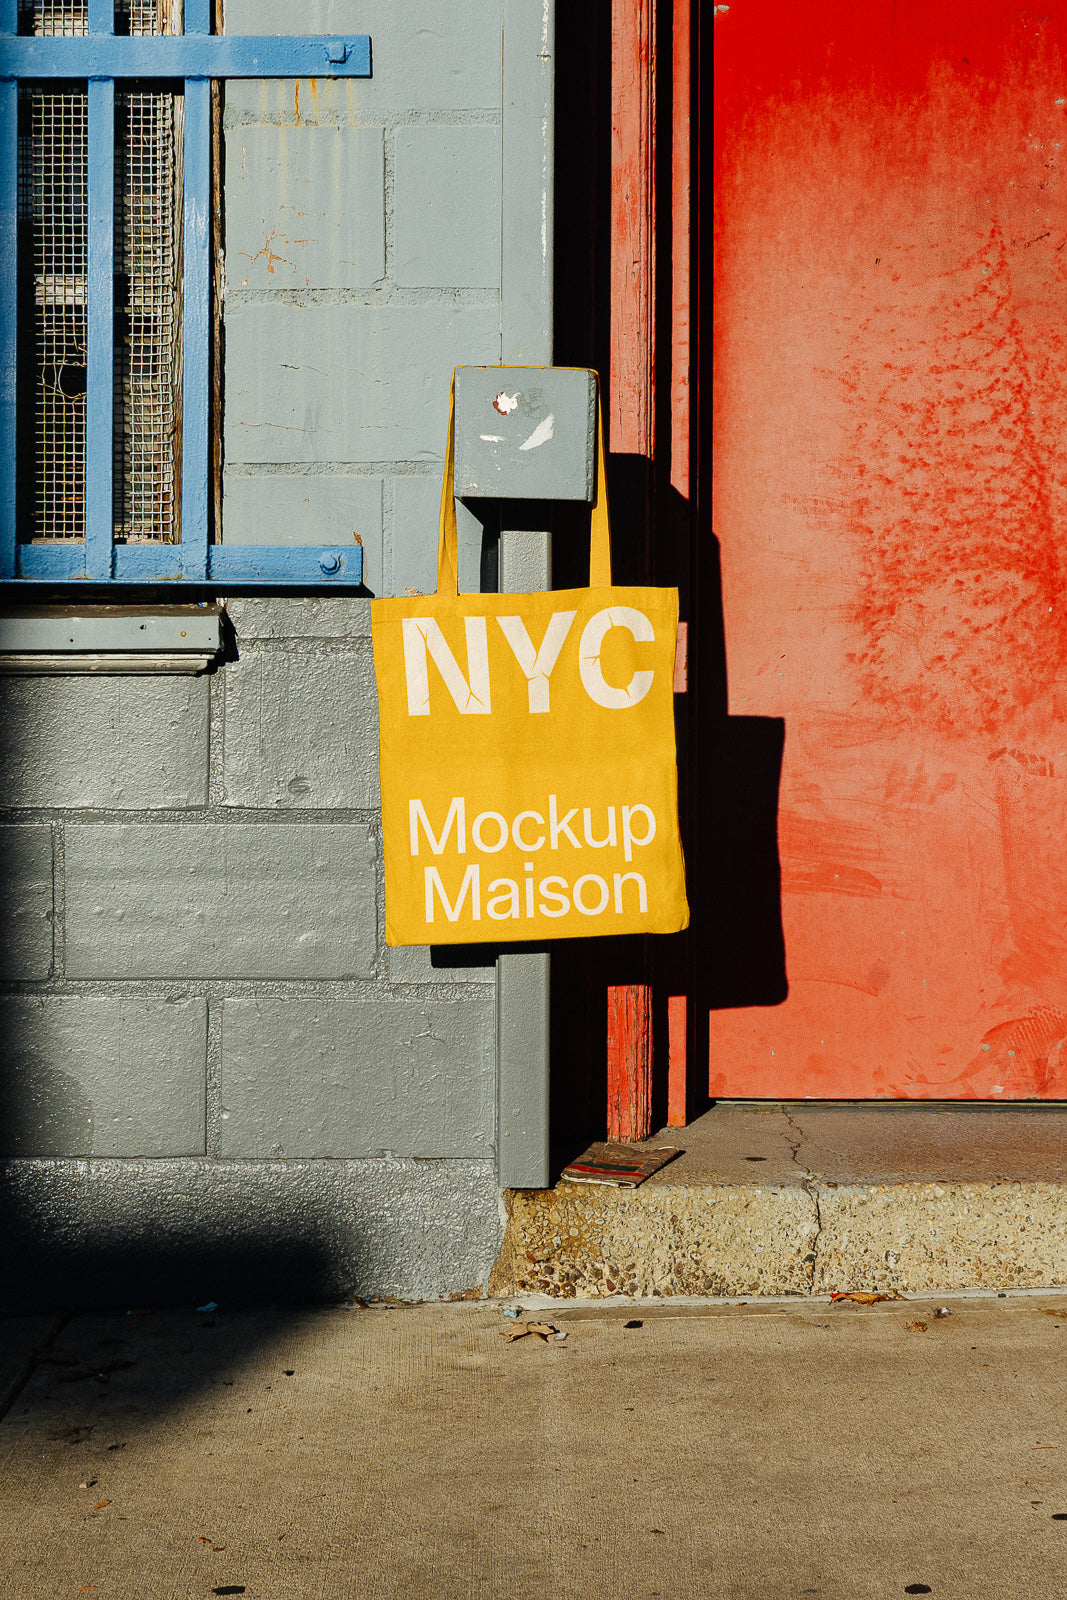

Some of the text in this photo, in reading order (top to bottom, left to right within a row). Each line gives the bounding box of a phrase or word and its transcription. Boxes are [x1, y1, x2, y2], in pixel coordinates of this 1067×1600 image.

[401, 606, 656, 716] NYC
[408, 794, 657, 862] Mockup
[423, 862, 648, 924] Maison
